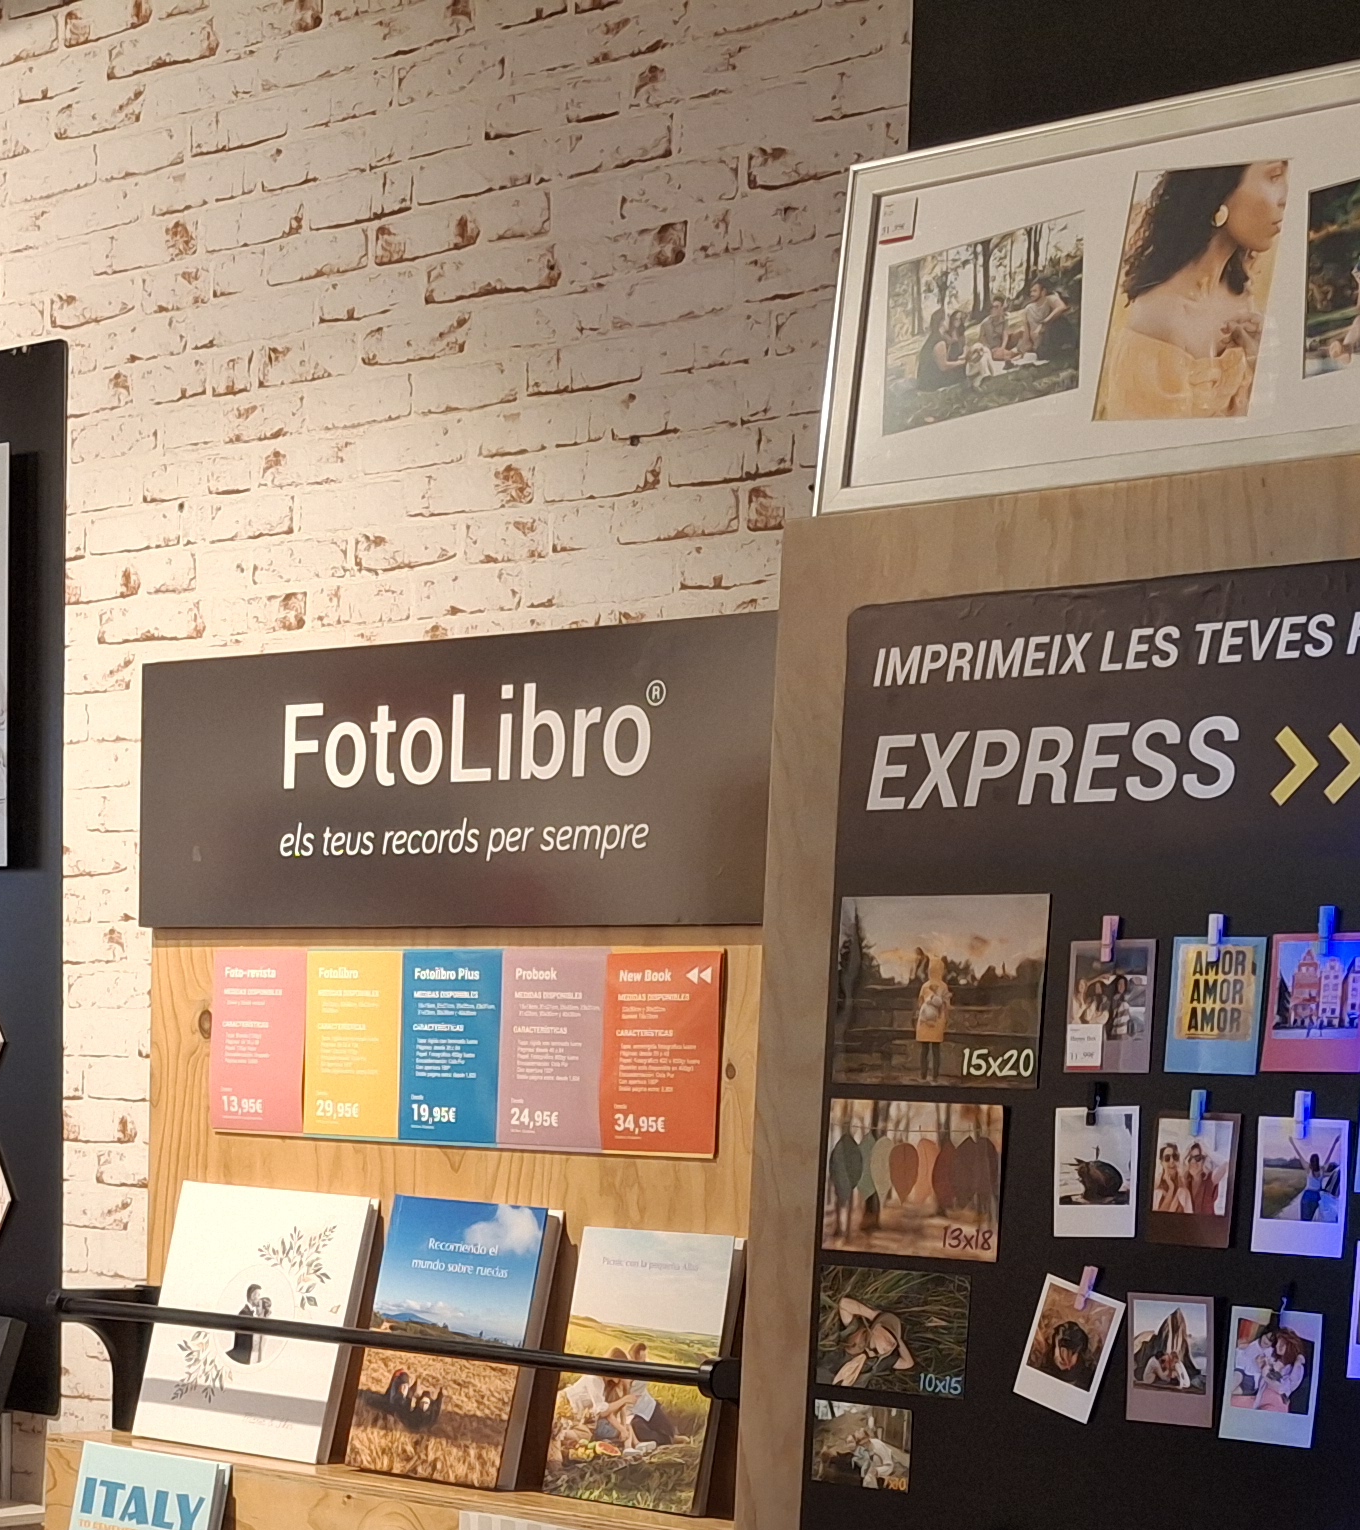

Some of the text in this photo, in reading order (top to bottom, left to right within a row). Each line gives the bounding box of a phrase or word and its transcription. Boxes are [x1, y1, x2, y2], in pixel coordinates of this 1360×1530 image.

[872, 631, 1095, 688] IMPRIMEIX
[1099, 625, 1181, 672] LES
[1194, 613, 1336, 666] TEVES
[865, 715, 1241, 812] EXPRESS
[278, 818, 650, 861] els teus records per sempre
[224, 966, 277, 980] Foto-revista
[318, 966, 360, 980] Fotolibro
[414, 967, 480, 981] Fotolibro Plus
[515, 966, 558, 981] Probook
[1192, 950, 1247, 976] AMOR
[619, 968, 673, 983] New Book
[1189, 978, 1244, 1005] AMOR
[1187, 1006, 1242, 1032] AMOR
[960, 1048, 1035, 1078] 15x20
[222, 1095, 263, 1115] 13,95€
[315, 1099, 360, 1120] 29,95€
[411, 1103, 457, 1125] 19,95€
[510, 1107, 559, 1130] 24,95€
[614, 1113, 666, 1135] 34,95€
[489, 1244, 499, 1257] el
[941, 1227, 994, 1252] 13x18
[411, 1259, 509, 1279] mundo sobre ruedas
[918, 1371, 963, 1395] 10x15
[79, 1519, 91, 1529] TO
